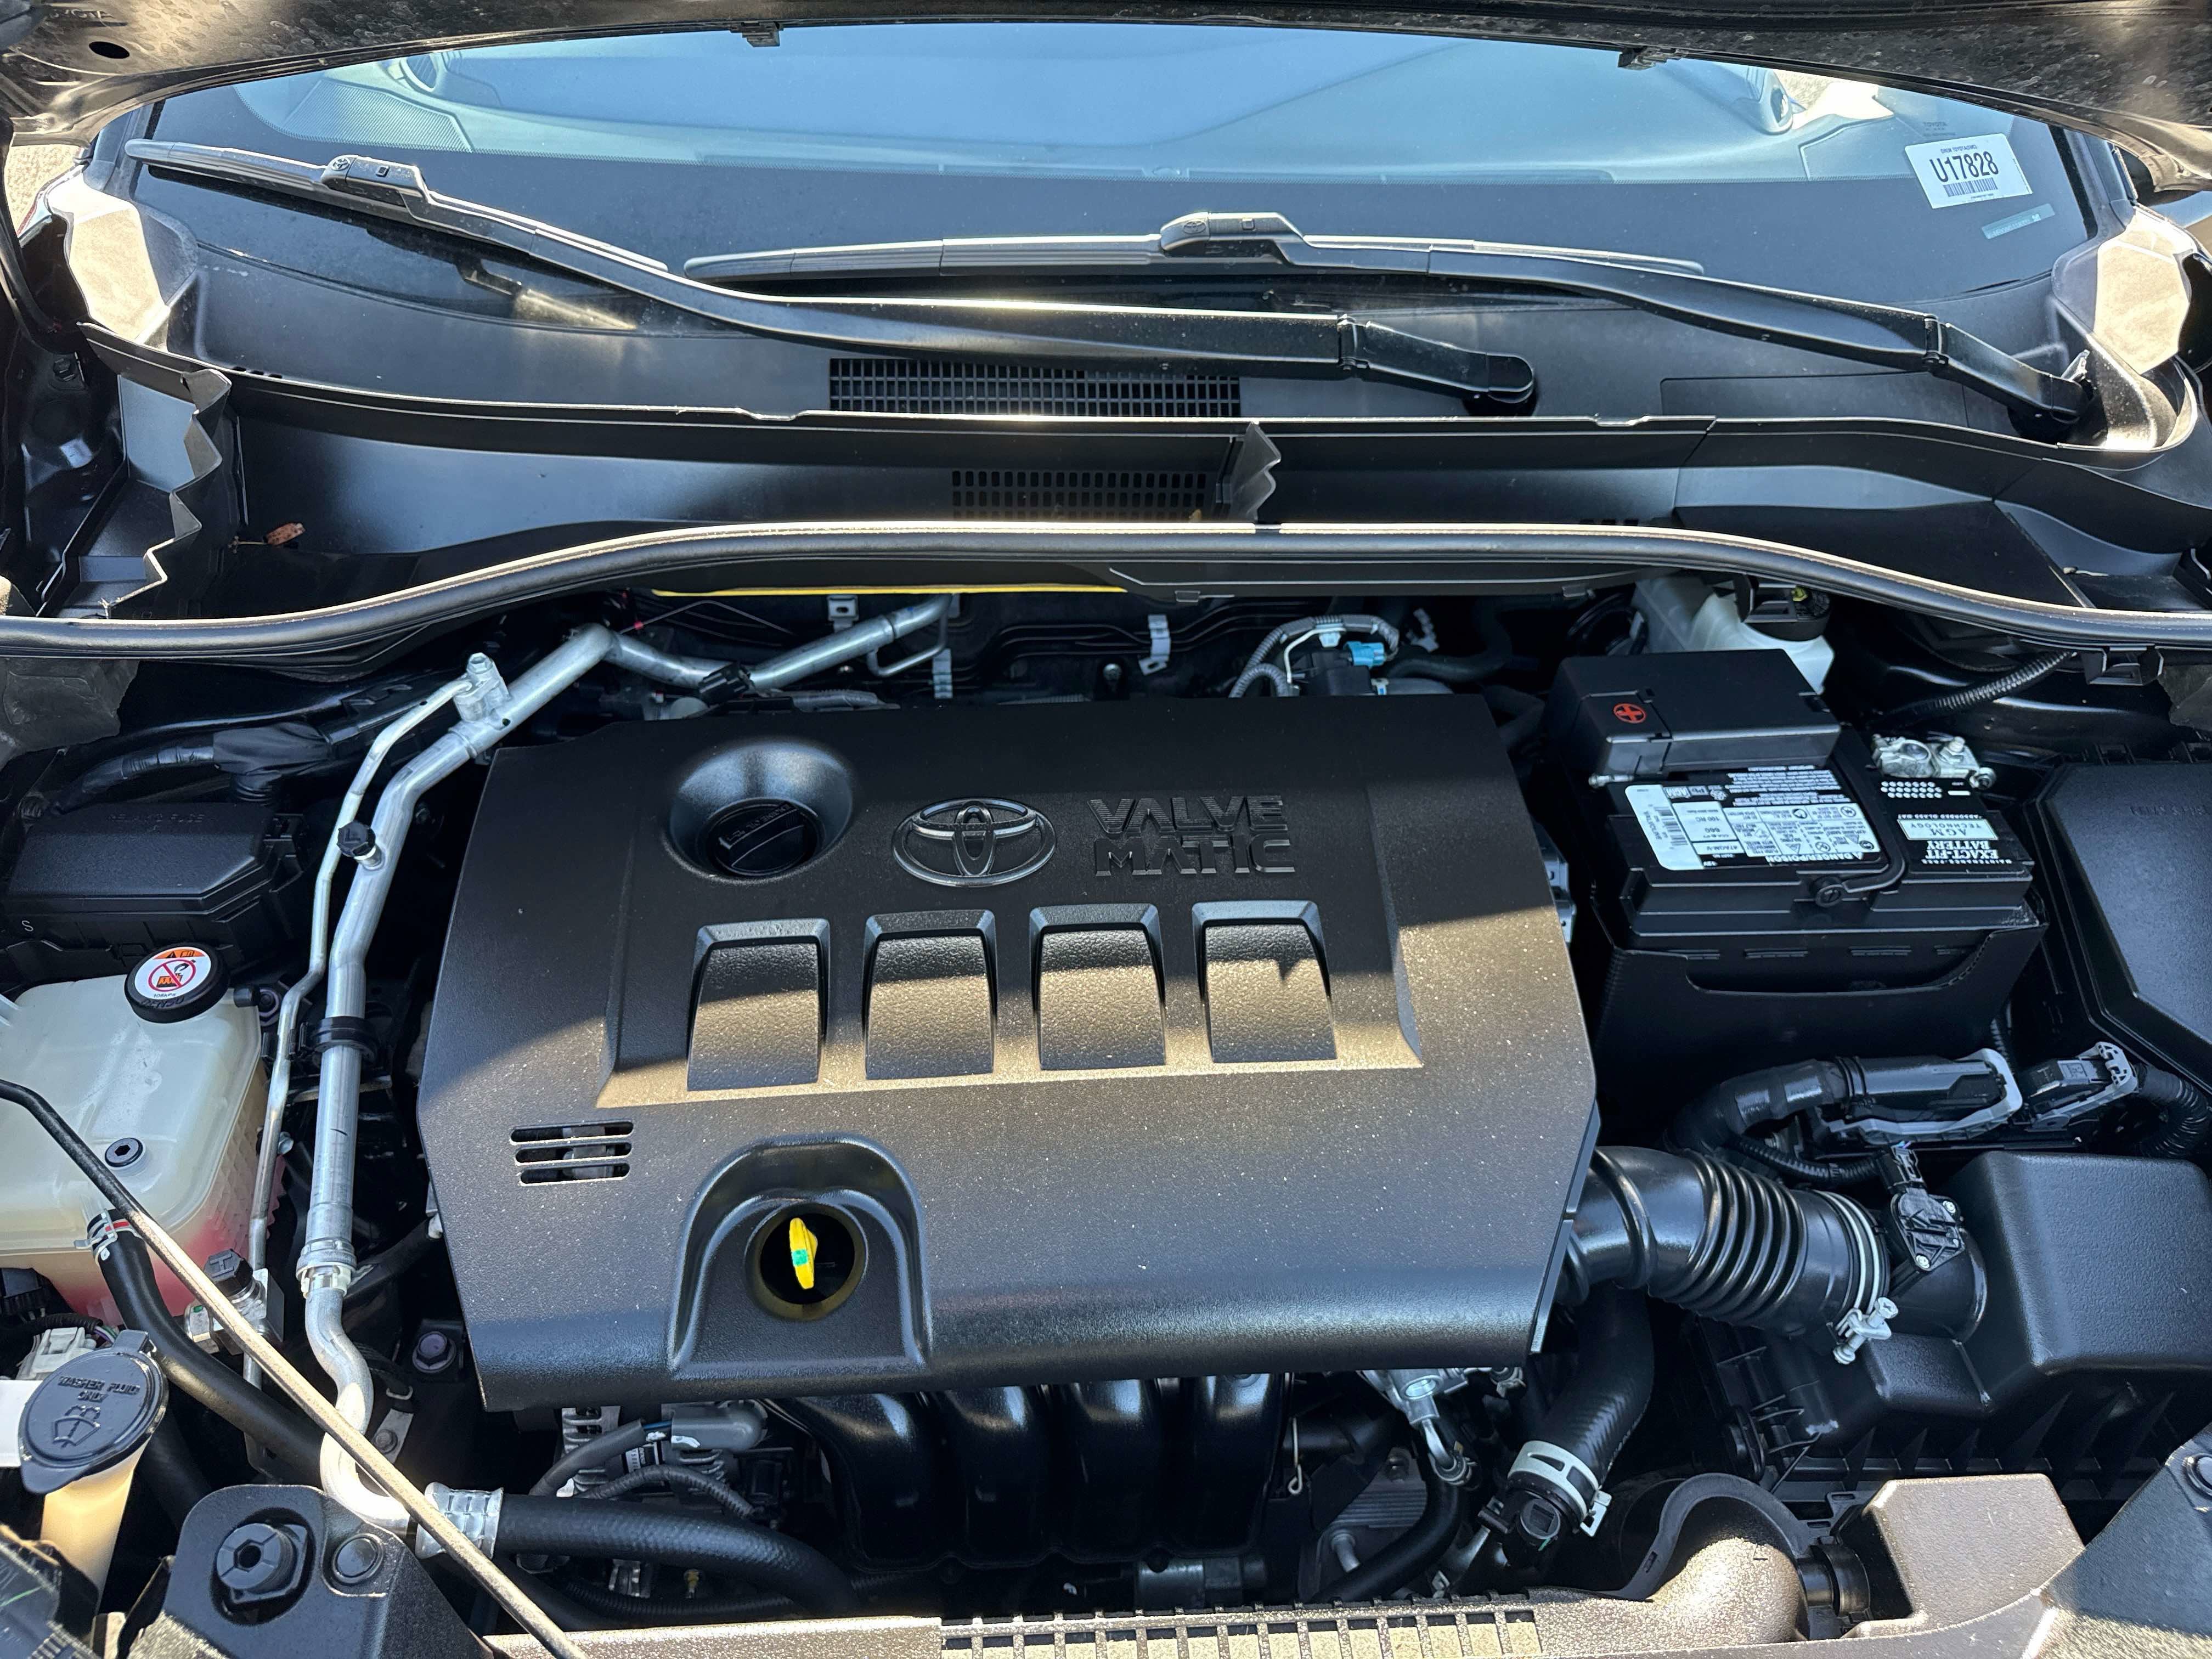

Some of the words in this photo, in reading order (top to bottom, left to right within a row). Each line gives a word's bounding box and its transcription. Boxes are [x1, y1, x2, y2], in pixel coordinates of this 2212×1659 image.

[1929, 151, 1999, 182] U17828
[1086, 793, 1287, 834] VALVE
[1926, 840, 1991, 850] BATTERY
[1094, 833, 1296, 877] MATIC
[1765, 853, 1854, 862] DANGER/POISON
[1924, 850, 1999, 860] EXACT-FIT
[140, 996, 185, 1008] DENSO
[107, 1383, 140, 1395] FLUID
[77, 1390, 109, 1403] ONLY
